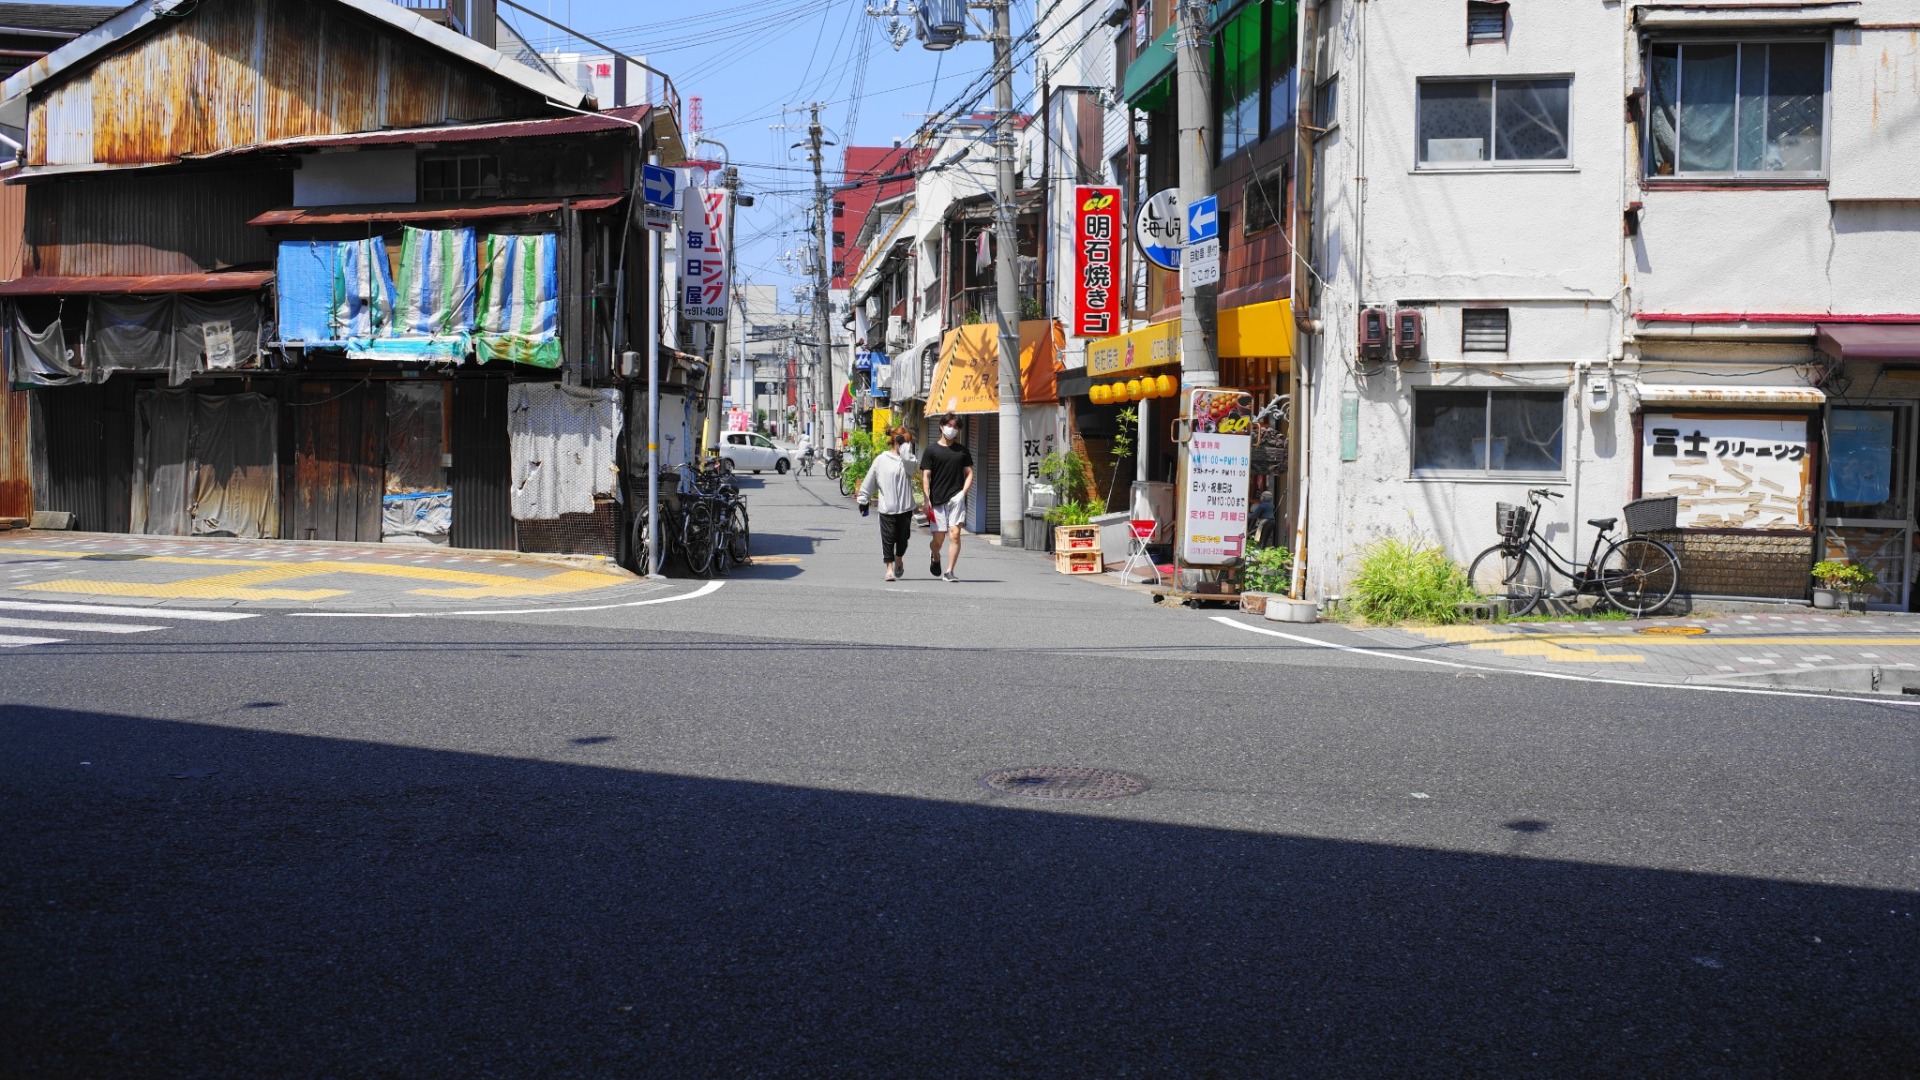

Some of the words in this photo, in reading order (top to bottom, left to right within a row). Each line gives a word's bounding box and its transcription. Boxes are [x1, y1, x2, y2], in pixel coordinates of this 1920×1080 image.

[686, 231, 703, 305] 毎日屋
[702, 193, 724, 305] クリーニング
[1191, 266, 1217, 283] ここから
[1024, 439, 1041, 479] 双月
[1190, 510, 1215, 520] 定休日
[1220, 511, 1246, 521] 月曜日
